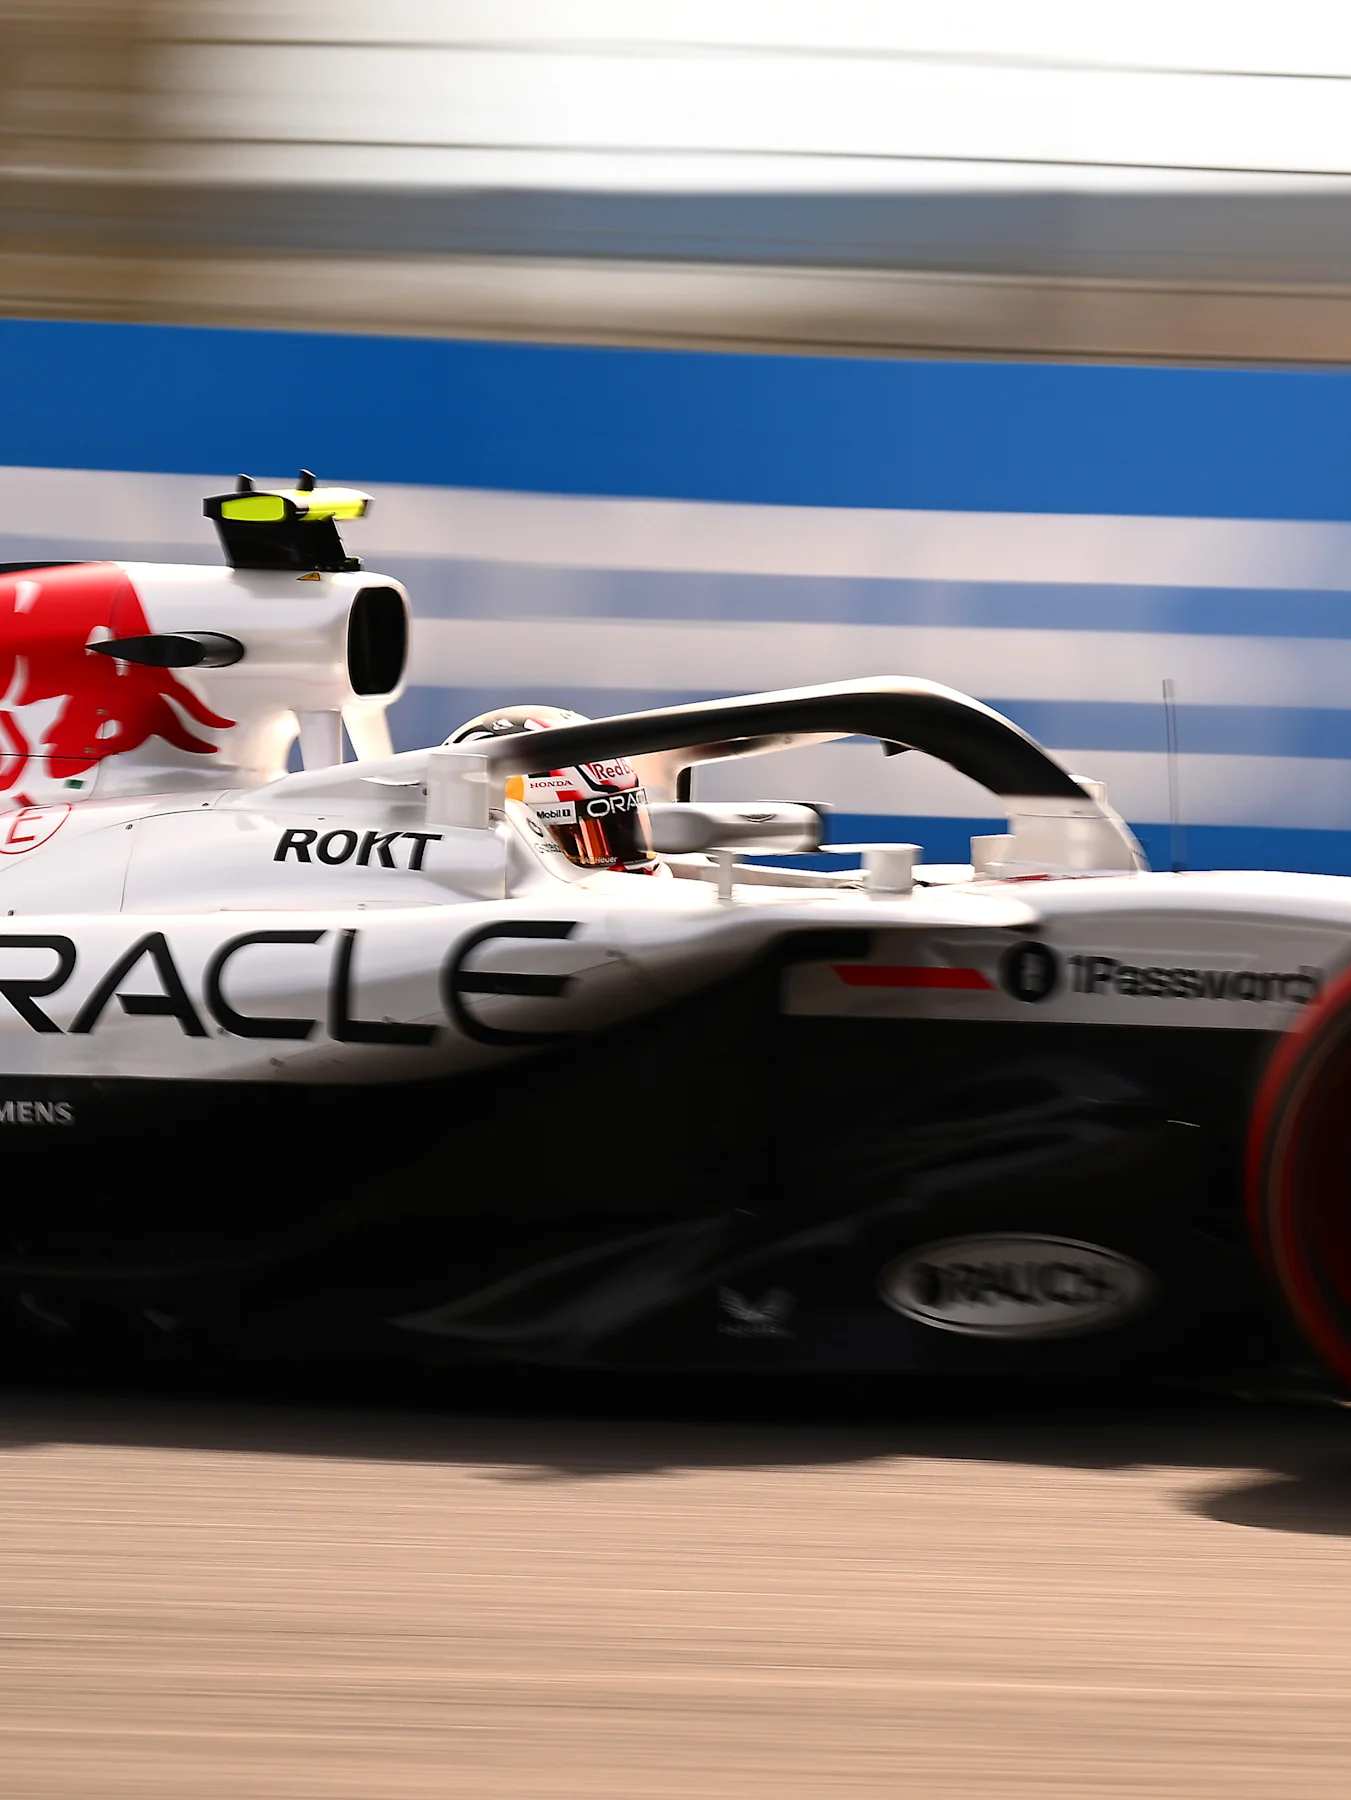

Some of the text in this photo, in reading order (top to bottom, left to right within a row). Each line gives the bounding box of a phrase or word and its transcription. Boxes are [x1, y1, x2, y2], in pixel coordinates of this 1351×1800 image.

[592, 758, 624, 780] Red
[529, 779, 574, 789] HONDA
[536, 809, 561, 819] Mobil
[273, 828, 444, 872] ROKT
